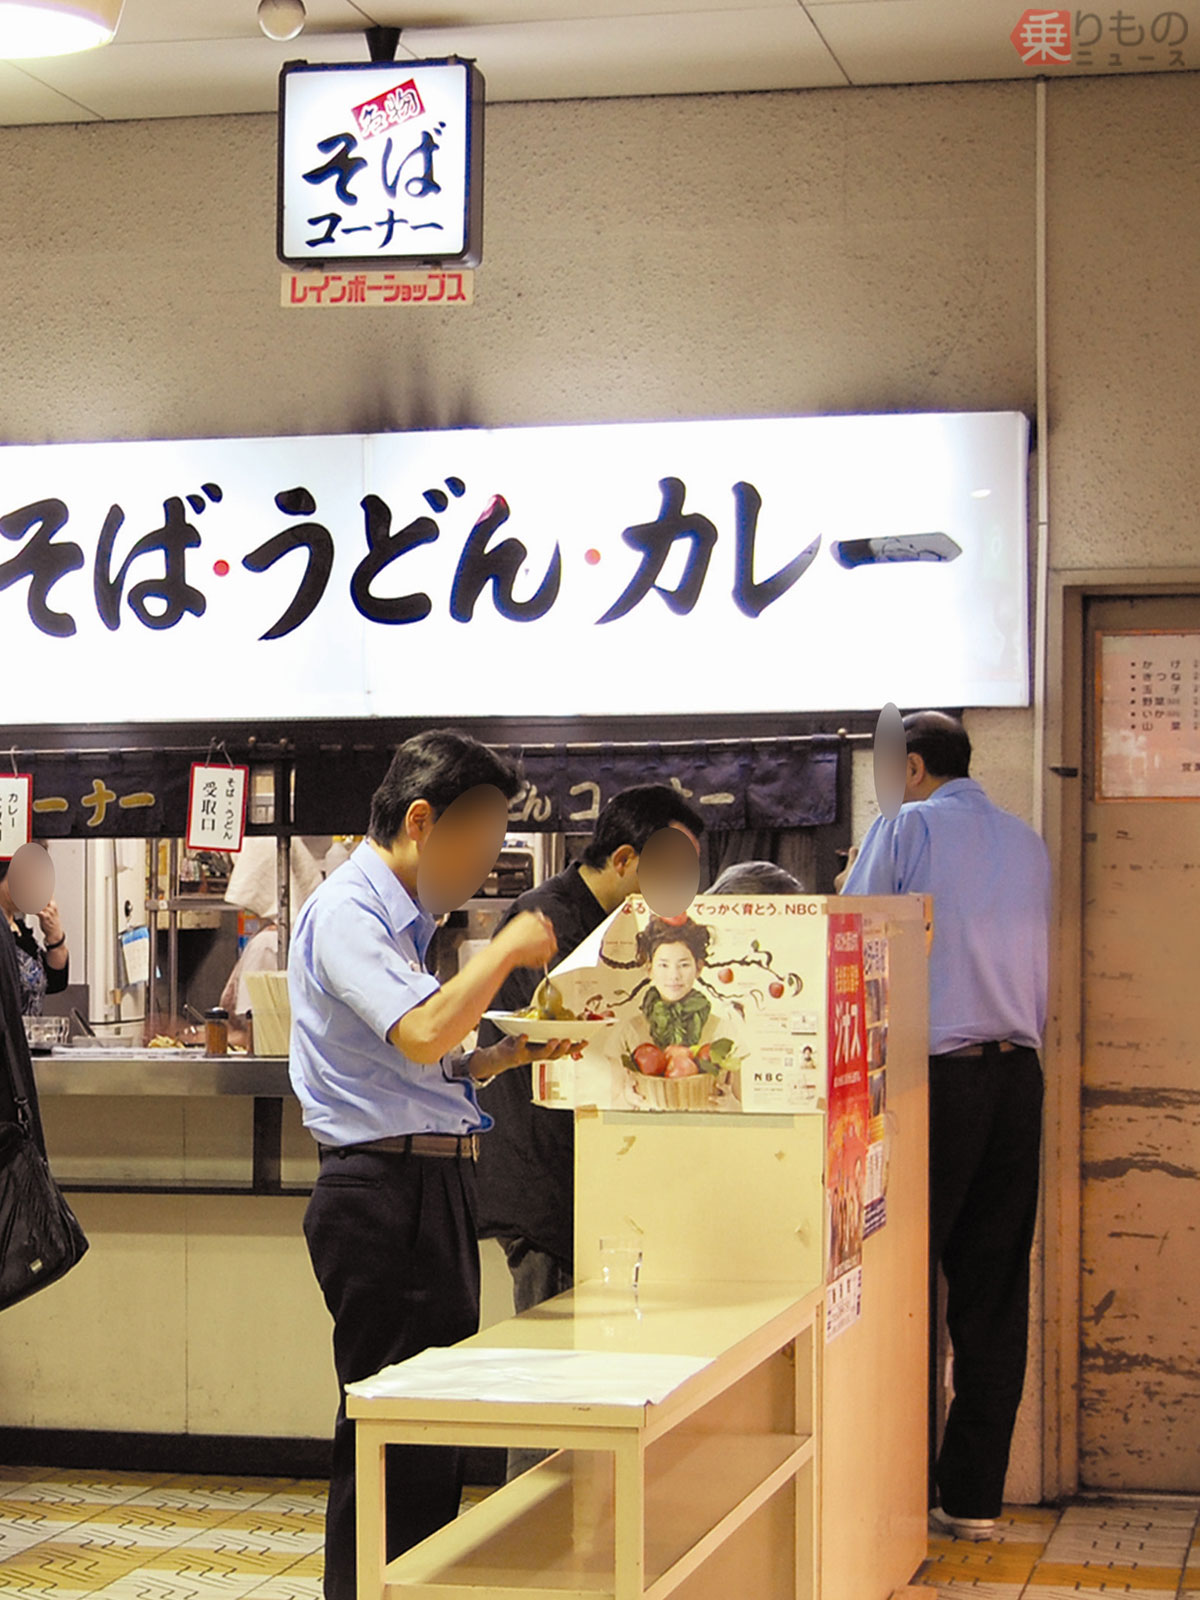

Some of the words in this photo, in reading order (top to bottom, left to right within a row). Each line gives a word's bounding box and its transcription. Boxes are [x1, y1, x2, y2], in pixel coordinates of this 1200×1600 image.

[359, 88, 421, 135] 名物
[302, 121, 446, 206] そば
[305, 208, 444, 248] コーナー
[290, 273, 467, 304] レインボーショップス
[8, 793, 19, 828] カレー
[201, 781, 218, 831] 受取口
[785, 903, 818, 916] NBC
[753, 1072, 784, 1082] NBC
